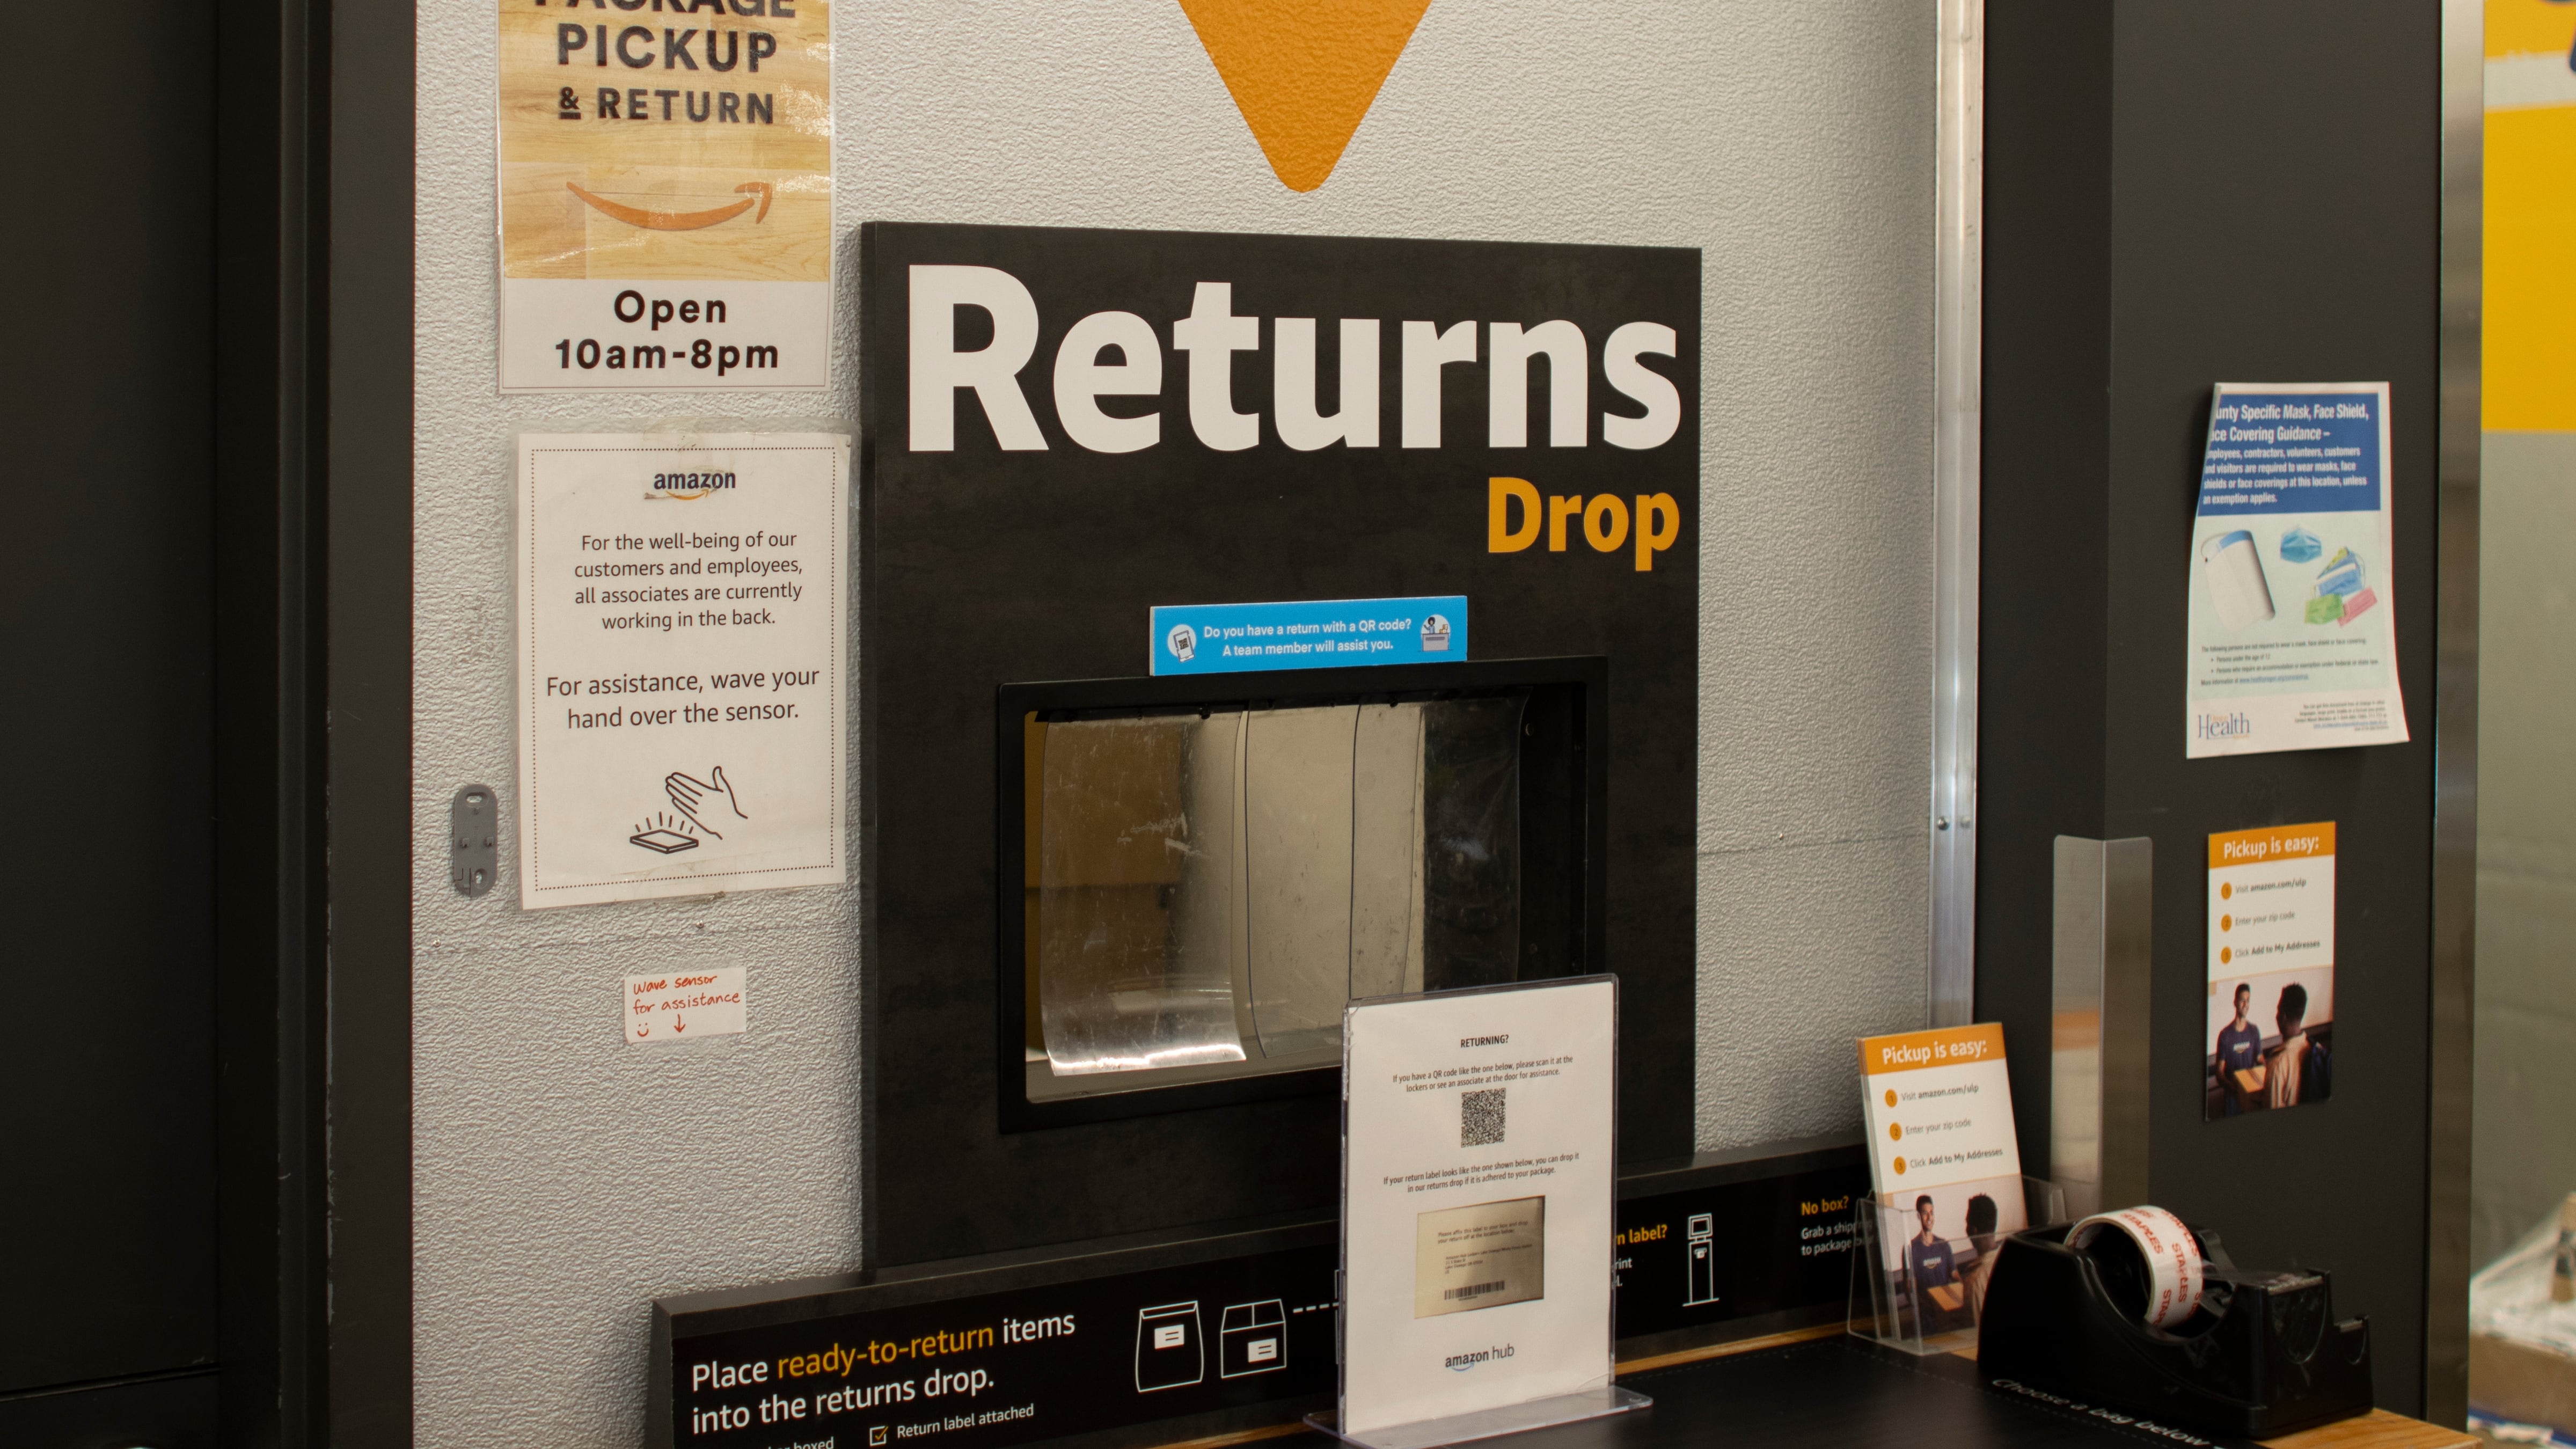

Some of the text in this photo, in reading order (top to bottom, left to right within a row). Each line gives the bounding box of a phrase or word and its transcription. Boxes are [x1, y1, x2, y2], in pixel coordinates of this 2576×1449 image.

[559, 24, 776, 72] PICKUP
[559, 86, 773, 124] & RETURN
[614, 290, 726, 331] Open
[556, 339, 778, 376] 10am-8pm
[910, 265, 1680, 453] Returns
[2241, 404, 2281, 422] Specific
[2283, 404, 2311, 421] Mask,
[2314, 404, 2335, 419] Face
[2337, 403, 2369, 420] Shield,
[2230, 426, 2322, 444] Covering Guidance
[654, 472, 736, 489] amazon
[1489, 477, 1679, 571] Drop
[583, 531, 797, 552] For the well-being of our
[575, 557, 802, 577] customers and employees,
[575, 582, 802, 604] all associates are currently
[602, 608, 775, 632] working in the back.
[1204, 619, 1411, 639] Do you have a return with a QR code?
[1223, 639, 1393, 656] A team member will assist you.
[548, 671, 819, 696] For assistance, wave your
[569, 703, 798, 728] hand over the sensor.
[2198, 712, 2250, 739] Health
[2224, 837, 2318, 859] Pickup is easy:
[634, 975, 717, 994] Wave sensor
[633, 992, 740, 1014] for assistance
[1461, 1035, 1509, 1048] RETURNING?
[1883, 1041, 1987, 1064] Pickup is easy:
[1399, 1075, 1410, 1084] you
[1433, 1070, 1442, 1079] QR
[1444, 1069, 1457, 1077] code
[1459, 1067, 1469, 1075] like
[1495, 1063, 1514, 1071] below,
[1516, 1061, 1534, 1070] please
[1407, 1084, 1428, 1092] lockers
[1457, 1077, 1484, 1086] associate
[1529, 1069, 1560, 1078] assistance.
[1901, 1084, 1979, 1101] Visit amazon.com/ulp
[1905, 1118, 1971, 1135] Enter your zip code
[1911, 1159, 1926, 1168] Click
[1929, 1155, 1943, 1165] Add
[1953, 1153, 1965, 1163] My
[1967, 1149, 2003, 1159] Addresses
[1383, 1176, 1389, 1184] If
[1390, 1177, 1403, 1186] your
[1426, 1170, 1440, 1179] label
[1442, 1168, 1458, 1177] looks
[1459, 1167, 1469, 1175] like
[1515, 1159, 1534, 1167] below,
[1536, 1158, 1546, 1166] you
[1801, 1195, 1849, 1216] No box?
[1629, 1224, 1667, 1243] label?
[1801, 1226, 1824, 1239] Grab
[1826, 1227, 1832, 1235] a
[1801, 1246, 1812, 1256] to
[1814, 1239, 1851, 1257] package
[693, 1315, 1075, 1391] Place ready-to-return items
[1445, 1343, 1514, 1368] amazon hub
[693, 1369, 993, 1434] into the returns drop.
[1992, 1379, 2070, 1405] Choose
[2088, 1408, 2135, 1424] bag
[2134, 1421, 2211, 1445] below
[897, 1403, 1034, 1438] Return label attached
